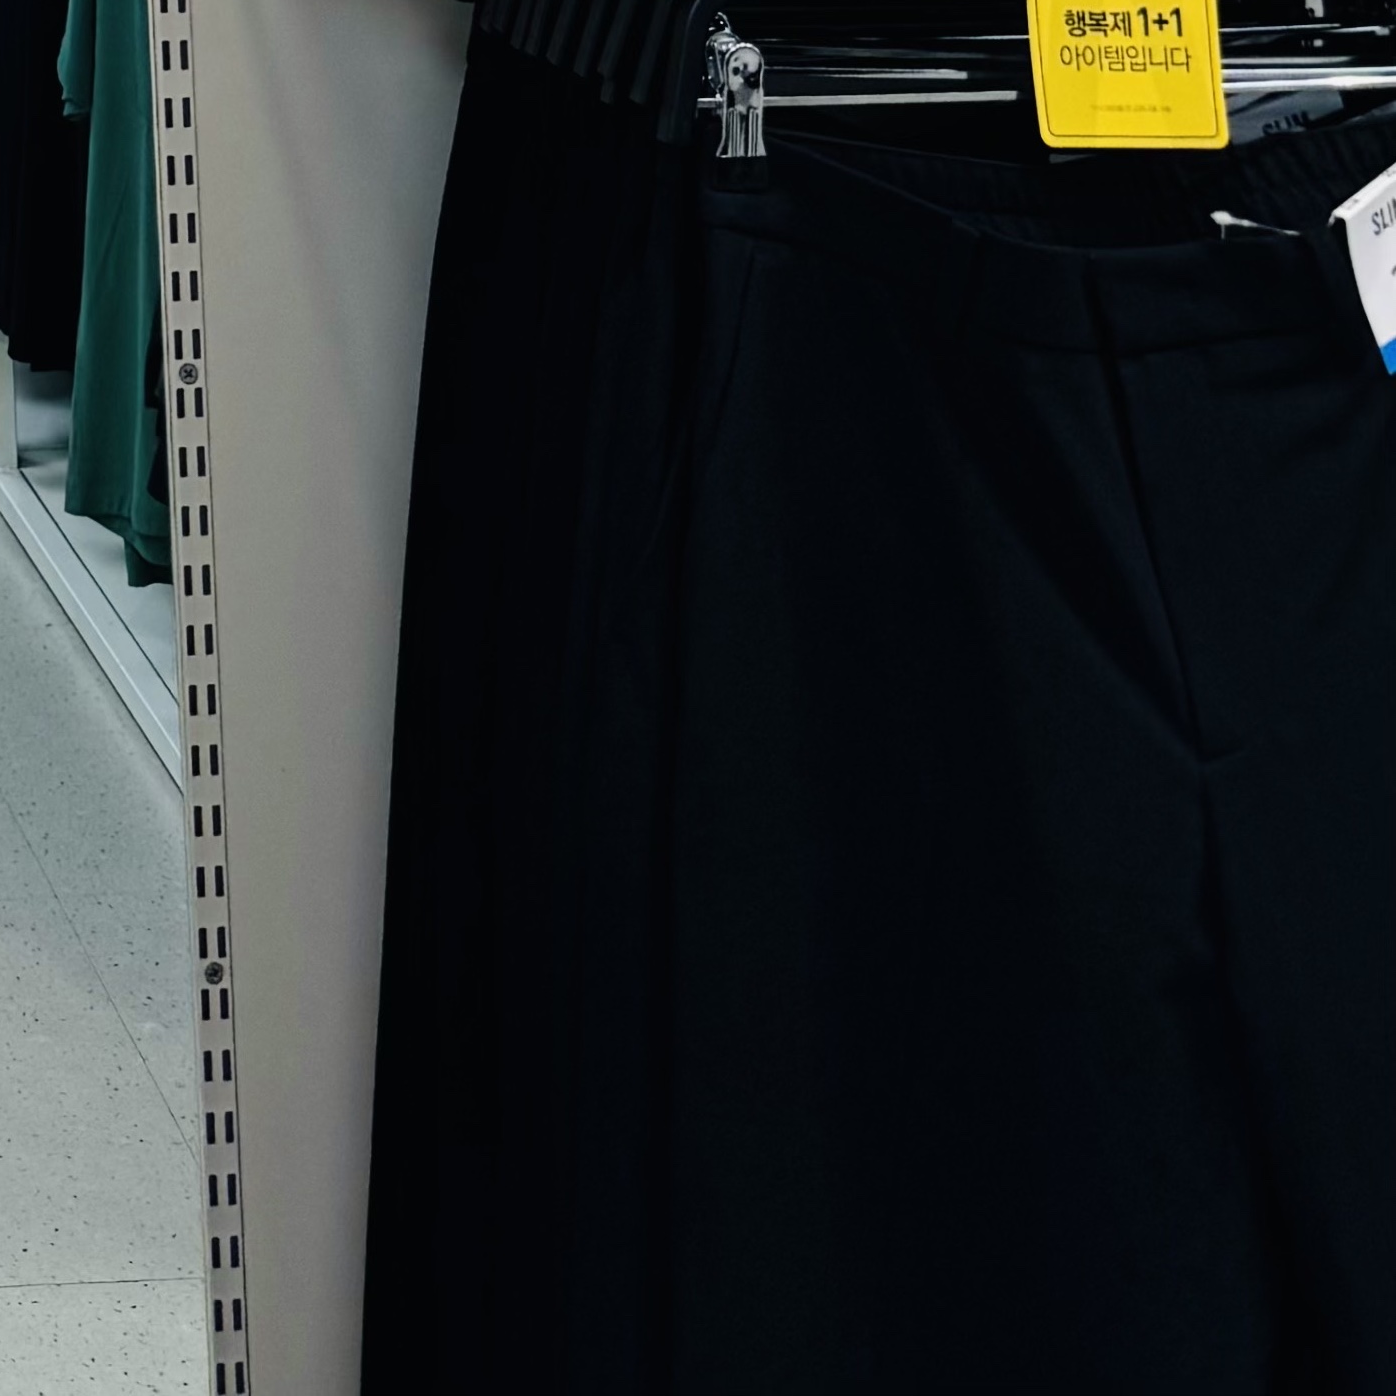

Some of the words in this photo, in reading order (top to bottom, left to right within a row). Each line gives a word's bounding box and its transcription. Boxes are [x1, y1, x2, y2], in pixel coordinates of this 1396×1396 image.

[1064, 9, 1132, 38] 행복제
[1136, 5, 1183, 38] 1+1
[1059, 44, 1192, 73] 아이템입니다
